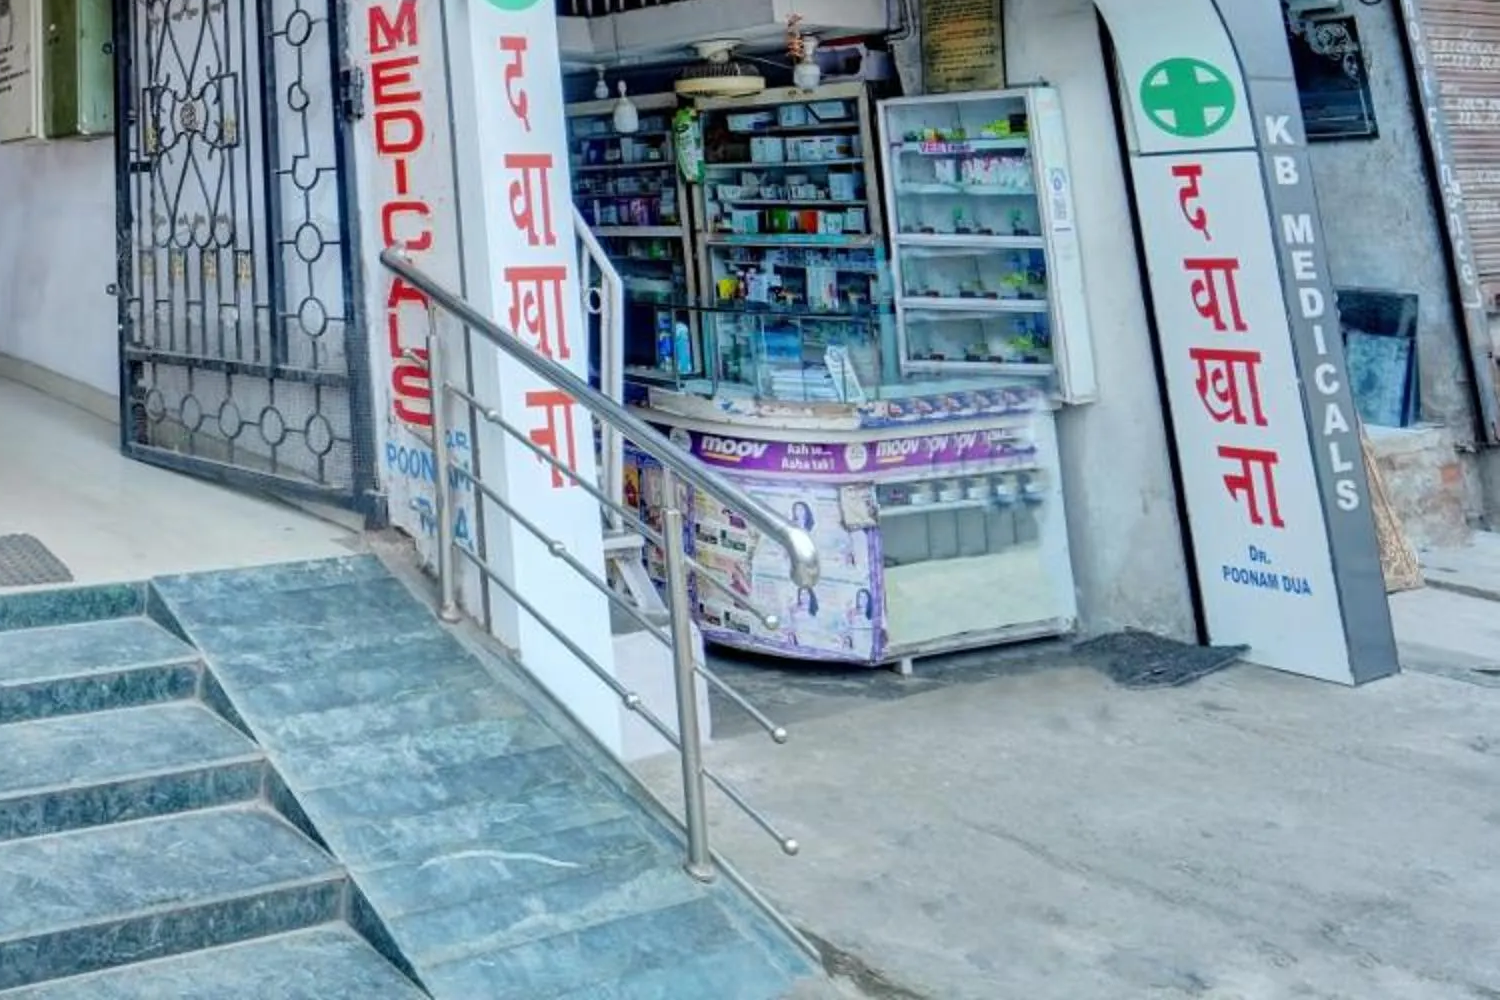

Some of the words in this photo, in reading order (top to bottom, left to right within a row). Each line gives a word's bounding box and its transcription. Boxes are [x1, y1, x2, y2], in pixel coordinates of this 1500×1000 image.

[1172, 165, 1285, 528] दवाखाना
[1282, 214, 1360, 511] MEDICALS
[385, 442, 471, 492] POONM
[702, 435, 768, 459] moov
[1222, 565, 1279, 590] POONAM
[1282, 575, 1313, 597] DUA
